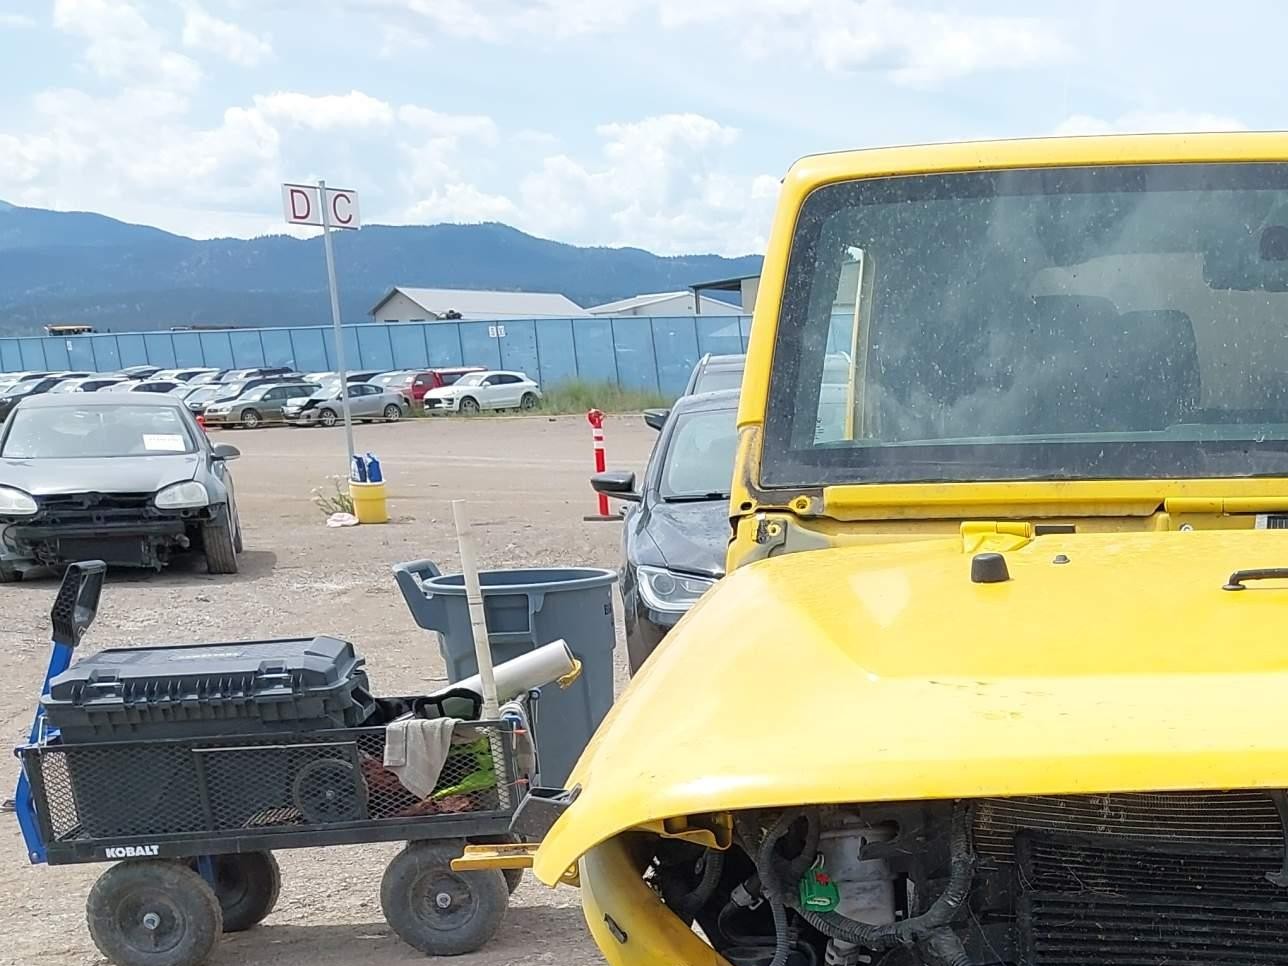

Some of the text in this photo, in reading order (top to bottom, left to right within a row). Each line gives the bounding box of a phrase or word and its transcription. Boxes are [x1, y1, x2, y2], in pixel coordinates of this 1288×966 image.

[290, 189, 310, 220] D
[333, 193, 352, 224] C
[105, 845, 159, 858] KOBALT
